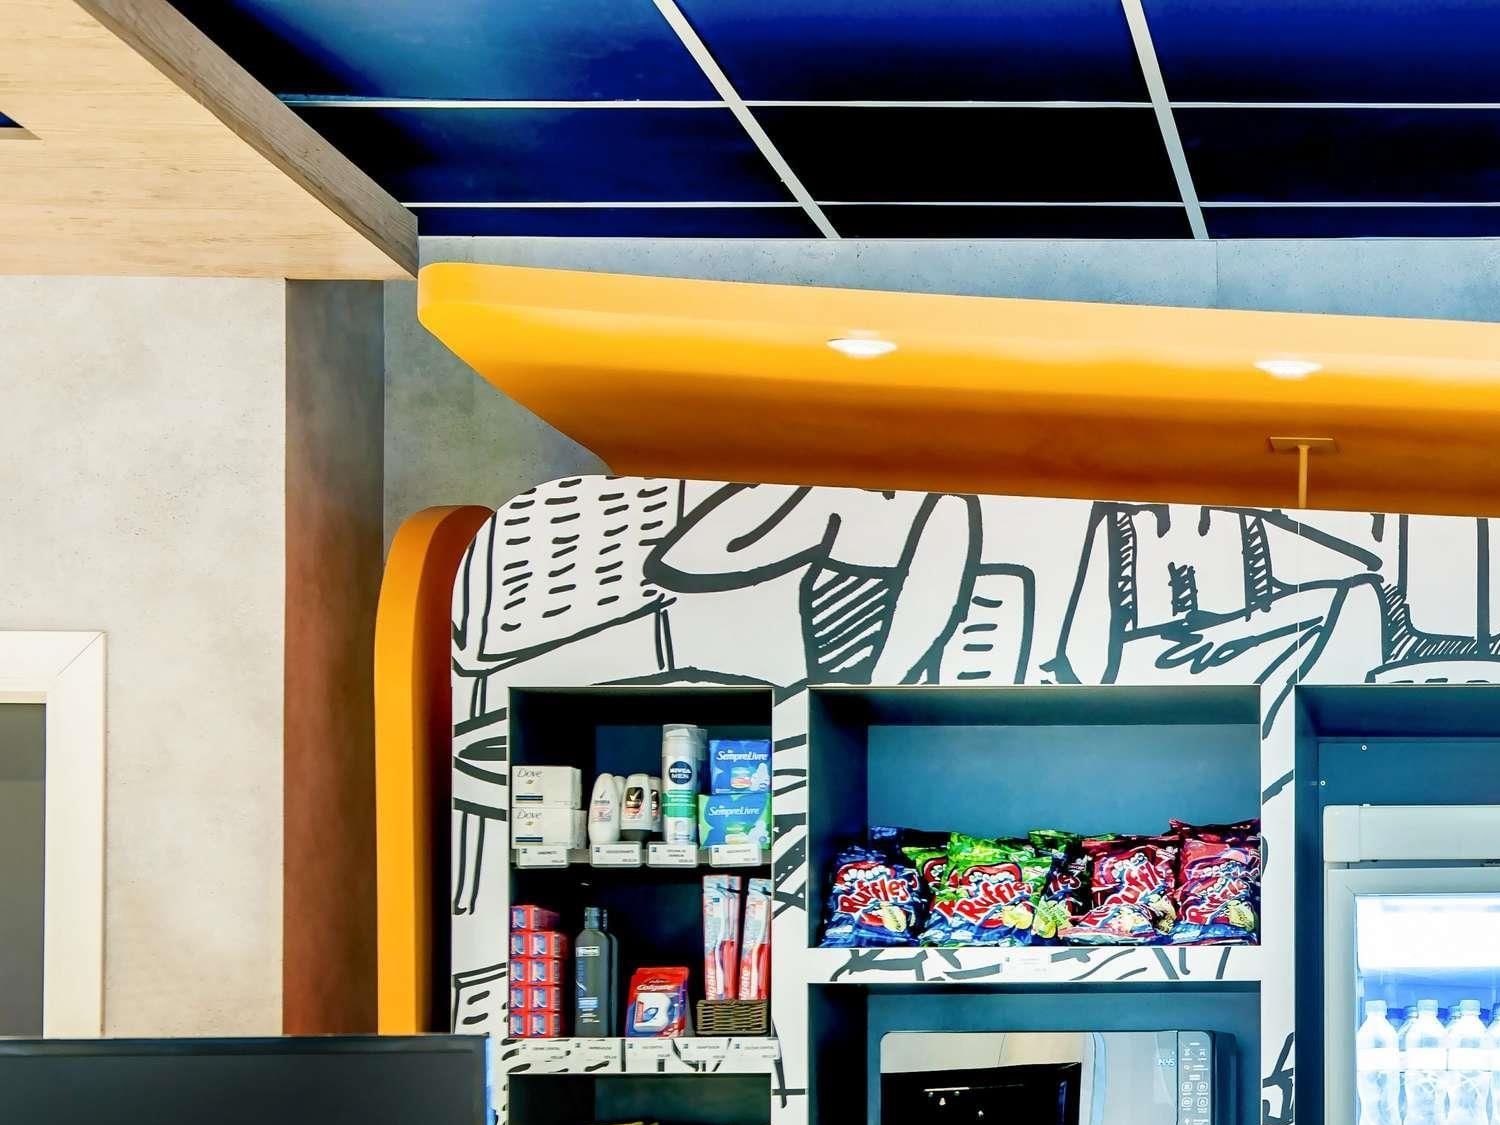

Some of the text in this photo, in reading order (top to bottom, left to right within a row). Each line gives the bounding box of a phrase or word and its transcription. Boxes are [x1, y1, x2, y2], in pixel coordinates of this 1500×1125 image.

[516, 767, 543, 779] Dove
[516, 808, 543, 820] Dove
[837, 874, 910, 914] Ruffles
[637, 984, 676, 992] Colgate
